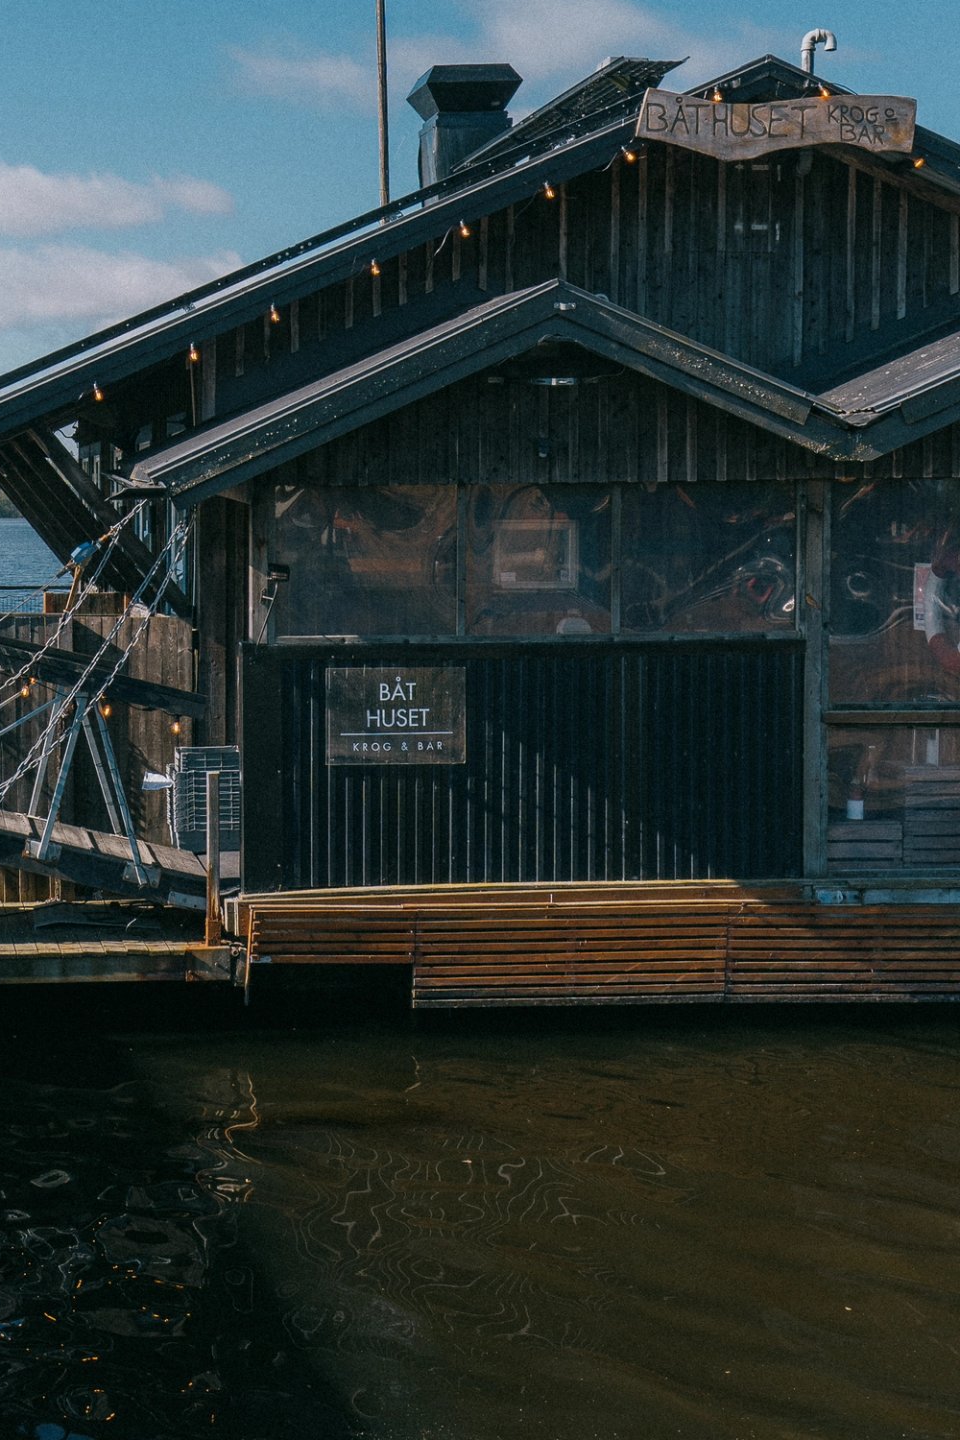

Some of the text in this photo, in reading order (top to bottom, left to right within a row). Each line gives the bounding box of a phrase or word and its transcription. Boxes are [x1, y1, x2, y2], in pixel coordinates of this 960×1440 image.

[645, 96, 818, 140] BÅTHUSET
[826, 104, 880, 124] KROG
[839, 123, 884, 145] BAR
[379, 676, 417, 701] BÅT
[366, 708, 430, 728] HUSET
[352, 741, 444, 752] KROG & BAR
